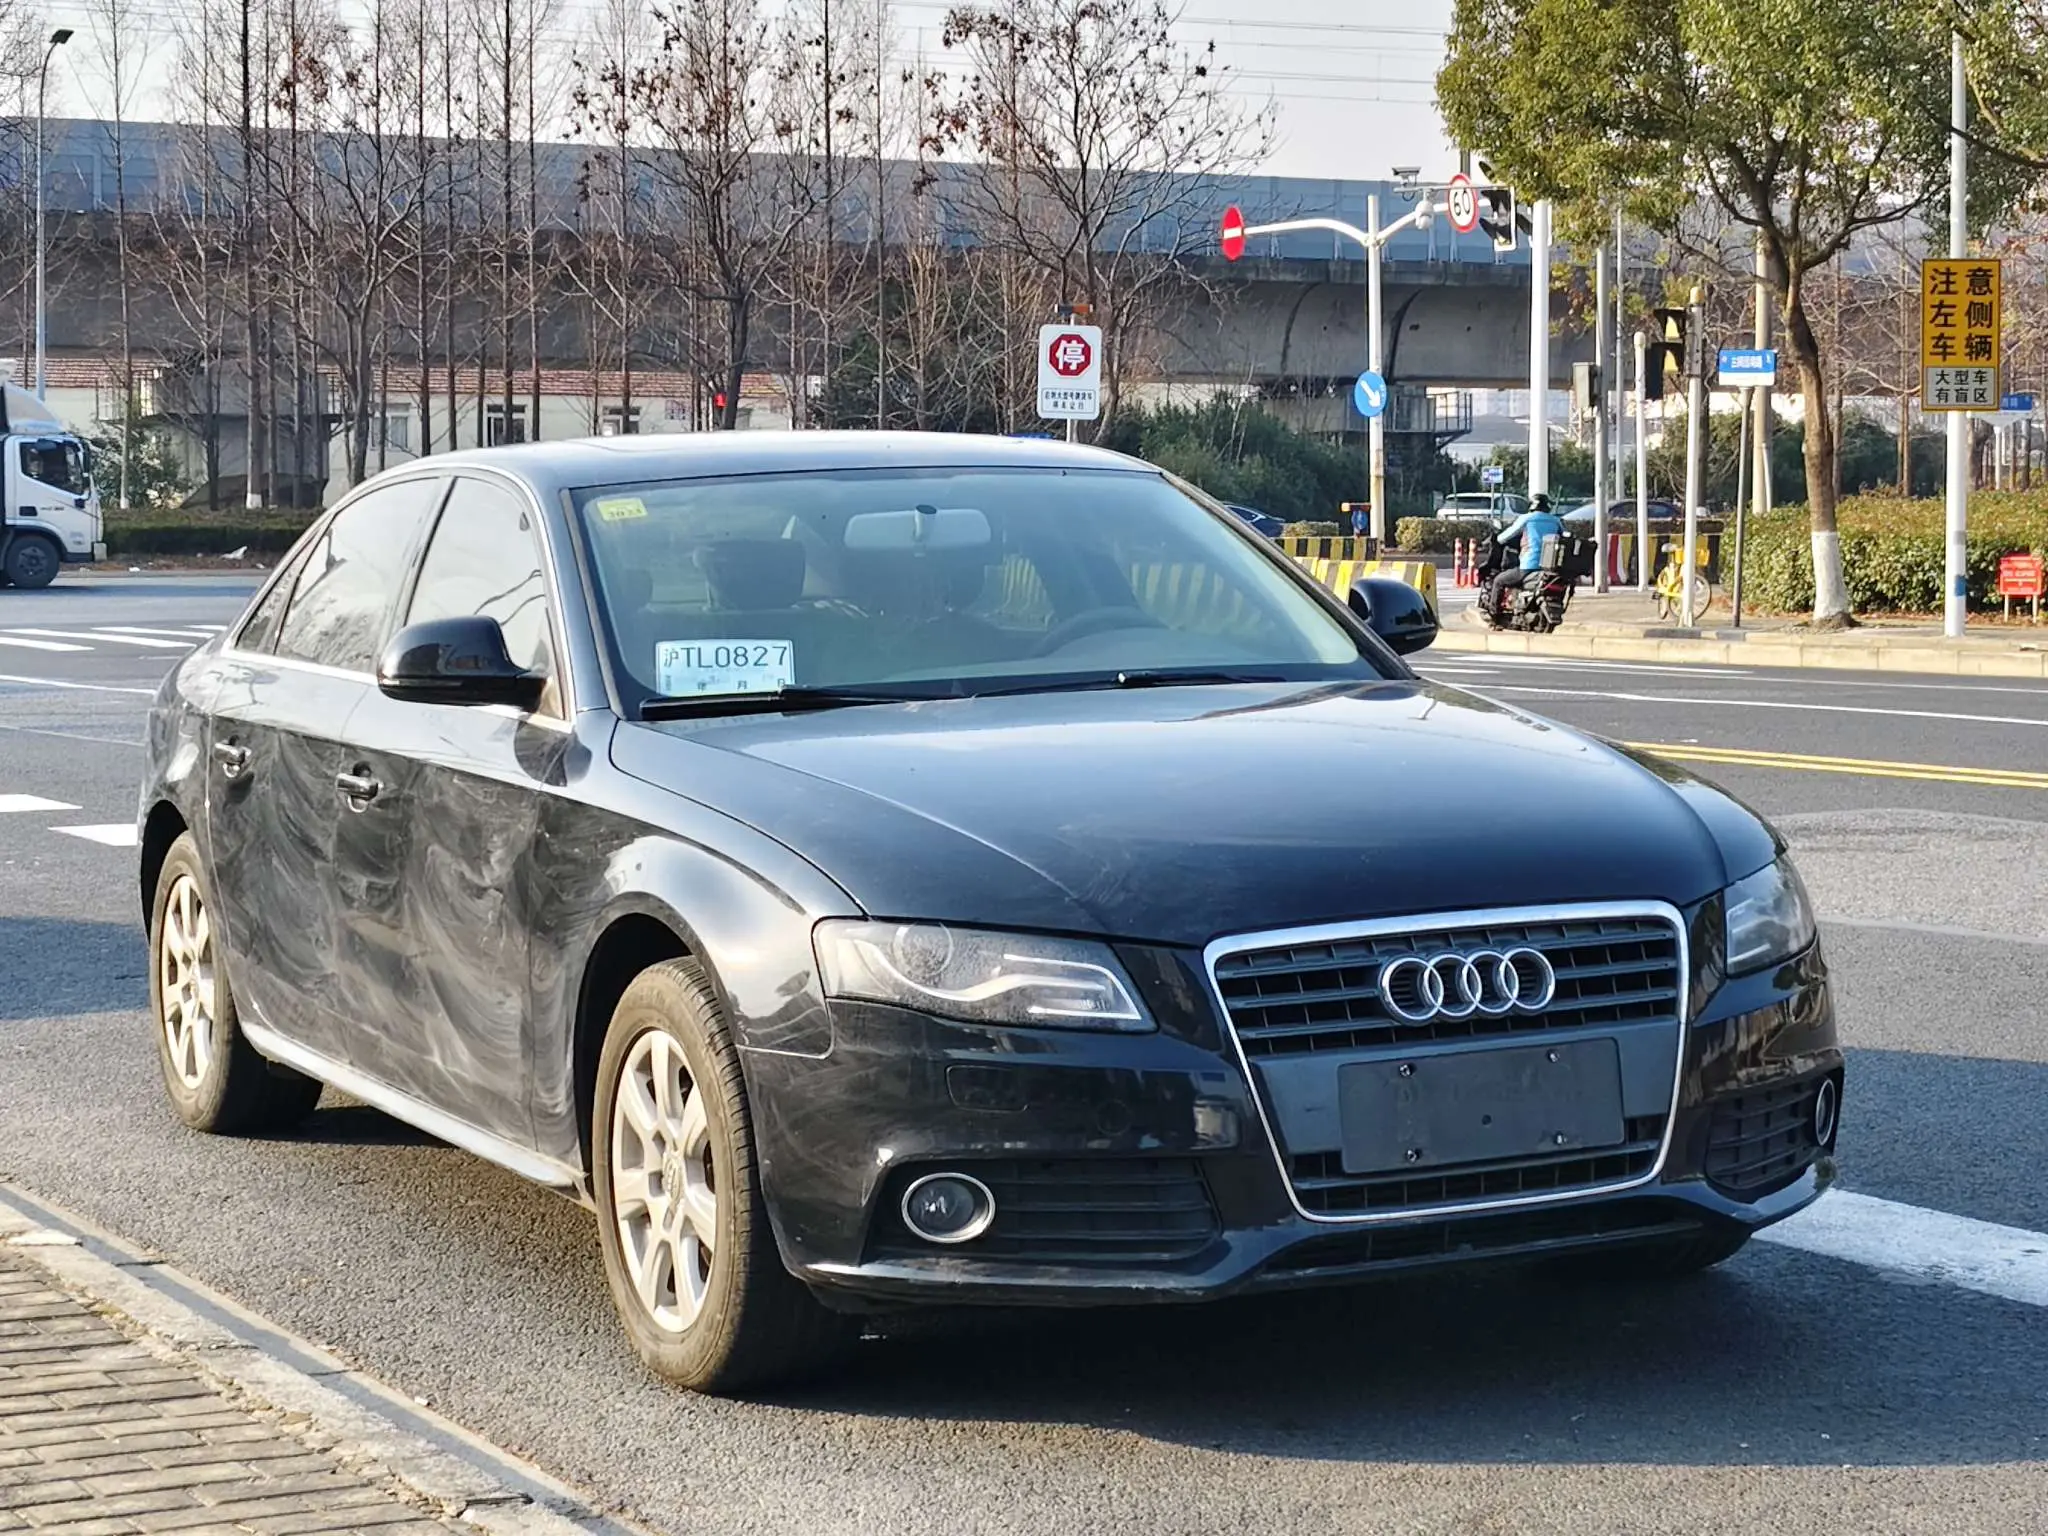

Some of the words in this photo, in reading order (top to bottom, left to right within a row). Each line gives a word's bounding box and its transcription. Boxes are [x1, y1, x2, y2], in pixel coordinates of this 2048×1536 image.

[1454, 188, 1471, 216] 60
[1929, 267, 1994, 296] 注意
[1929, 300, 1993, 329] 左侧
[1055, 339, 1085, 370] 停
[1929, 333, 1993, 362] 车辆
[1935, 370, 1988, 386] 大型车
[1935, 387, 1988, 403] 有盲区
[664, 646, 788, 668] 沪TL0827
